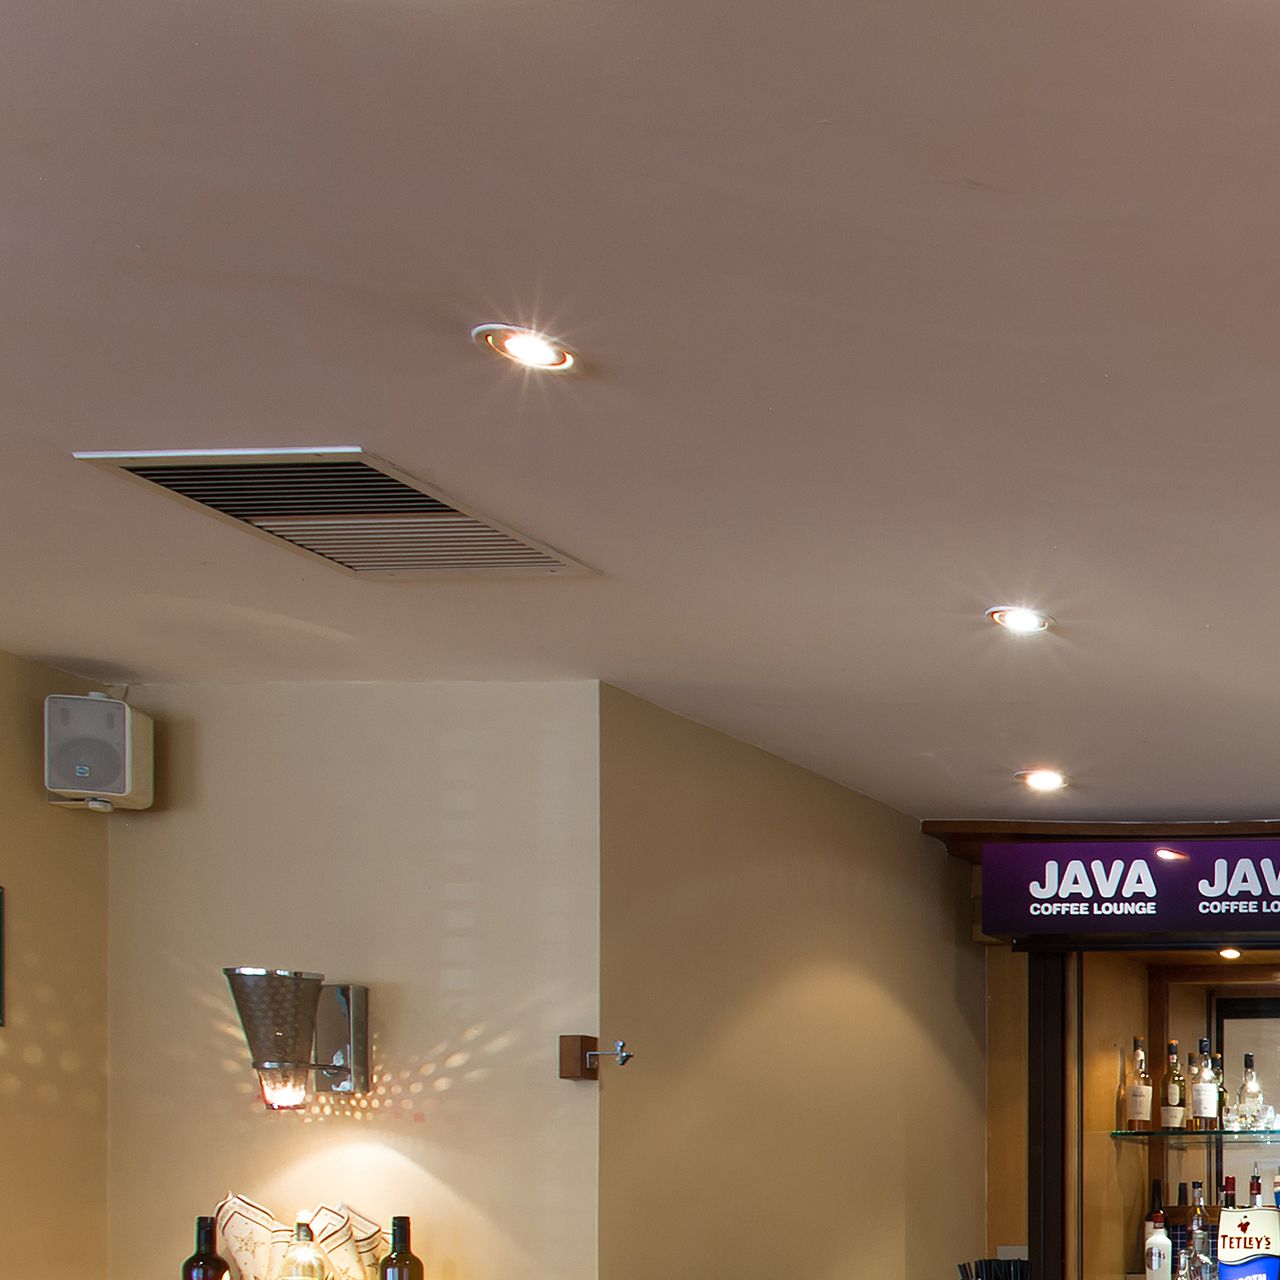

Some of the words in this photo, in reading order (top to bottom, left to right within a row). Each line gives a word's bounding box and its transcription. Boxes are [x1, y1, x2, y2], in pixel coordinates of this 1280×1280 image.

[1029, 860, 1157, 899] JAVA
[1029, 902, 1090, 916] COFFEE
[1093, 901, 1156, 914] LOUNGE
[1198, 900, 1258, 914] COFFEE
[1220, 1235, 1272, 1250] TETLEY'S
